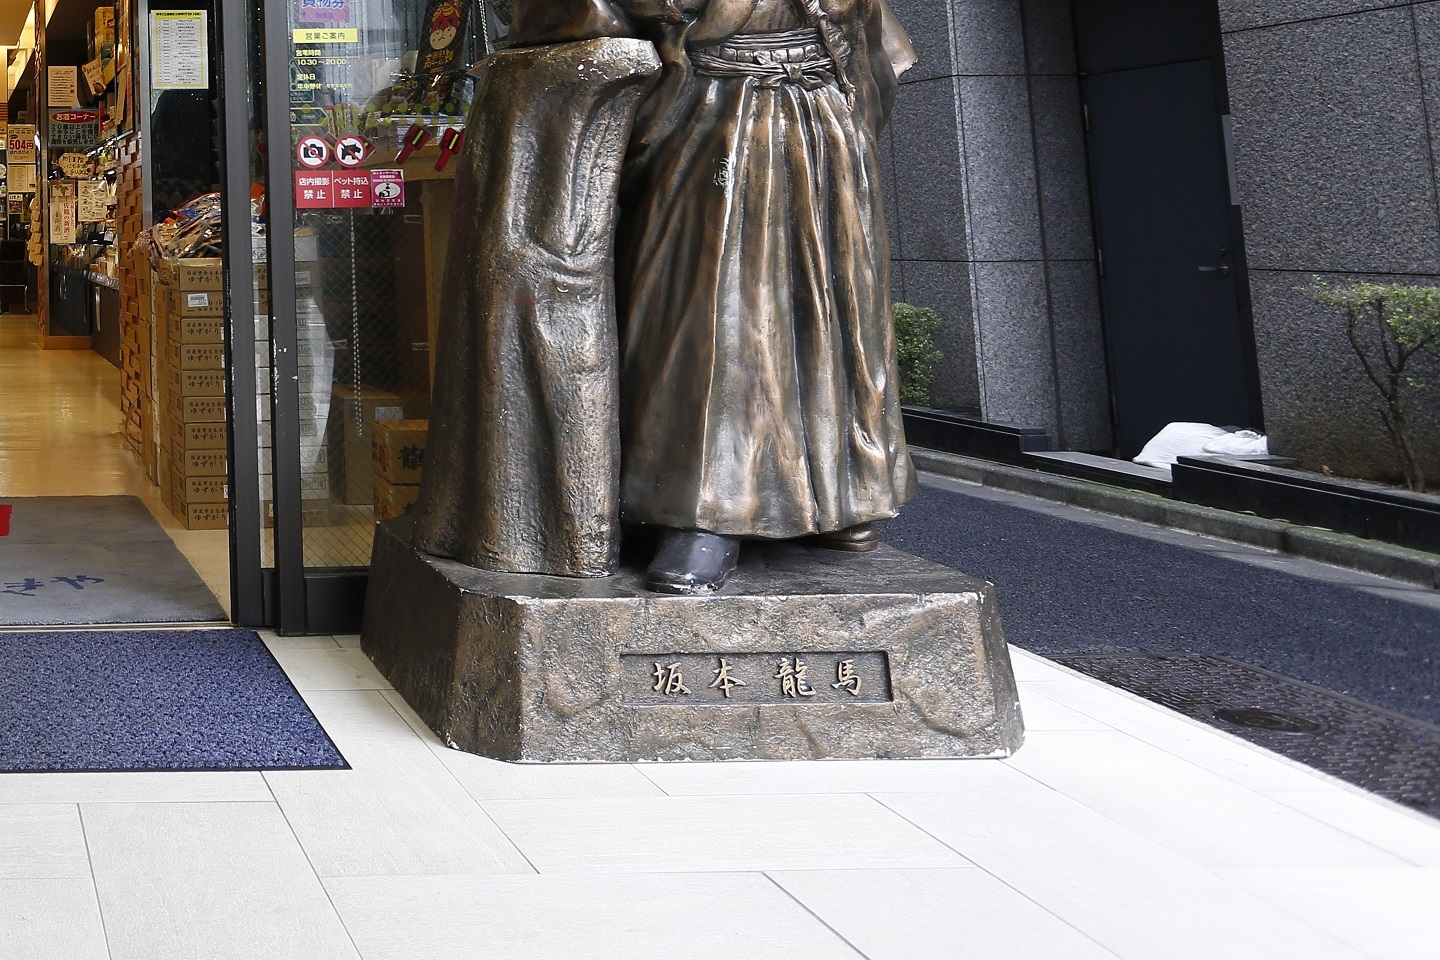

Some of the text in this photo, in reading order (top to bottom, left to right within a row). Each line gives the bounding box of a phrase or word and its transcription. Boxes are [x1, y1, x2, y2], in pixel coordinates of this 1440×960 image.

[305, 32, 346, 40] 営業ご案内
[10, 140, 33, 150] 504円
[298, 178, 330, 186] 店内撮影
[304, 189, 326, 199] 禁止
[340, 189, 363, 199] 禁止
[653, 657, 862, 698] 坂本龍馬
